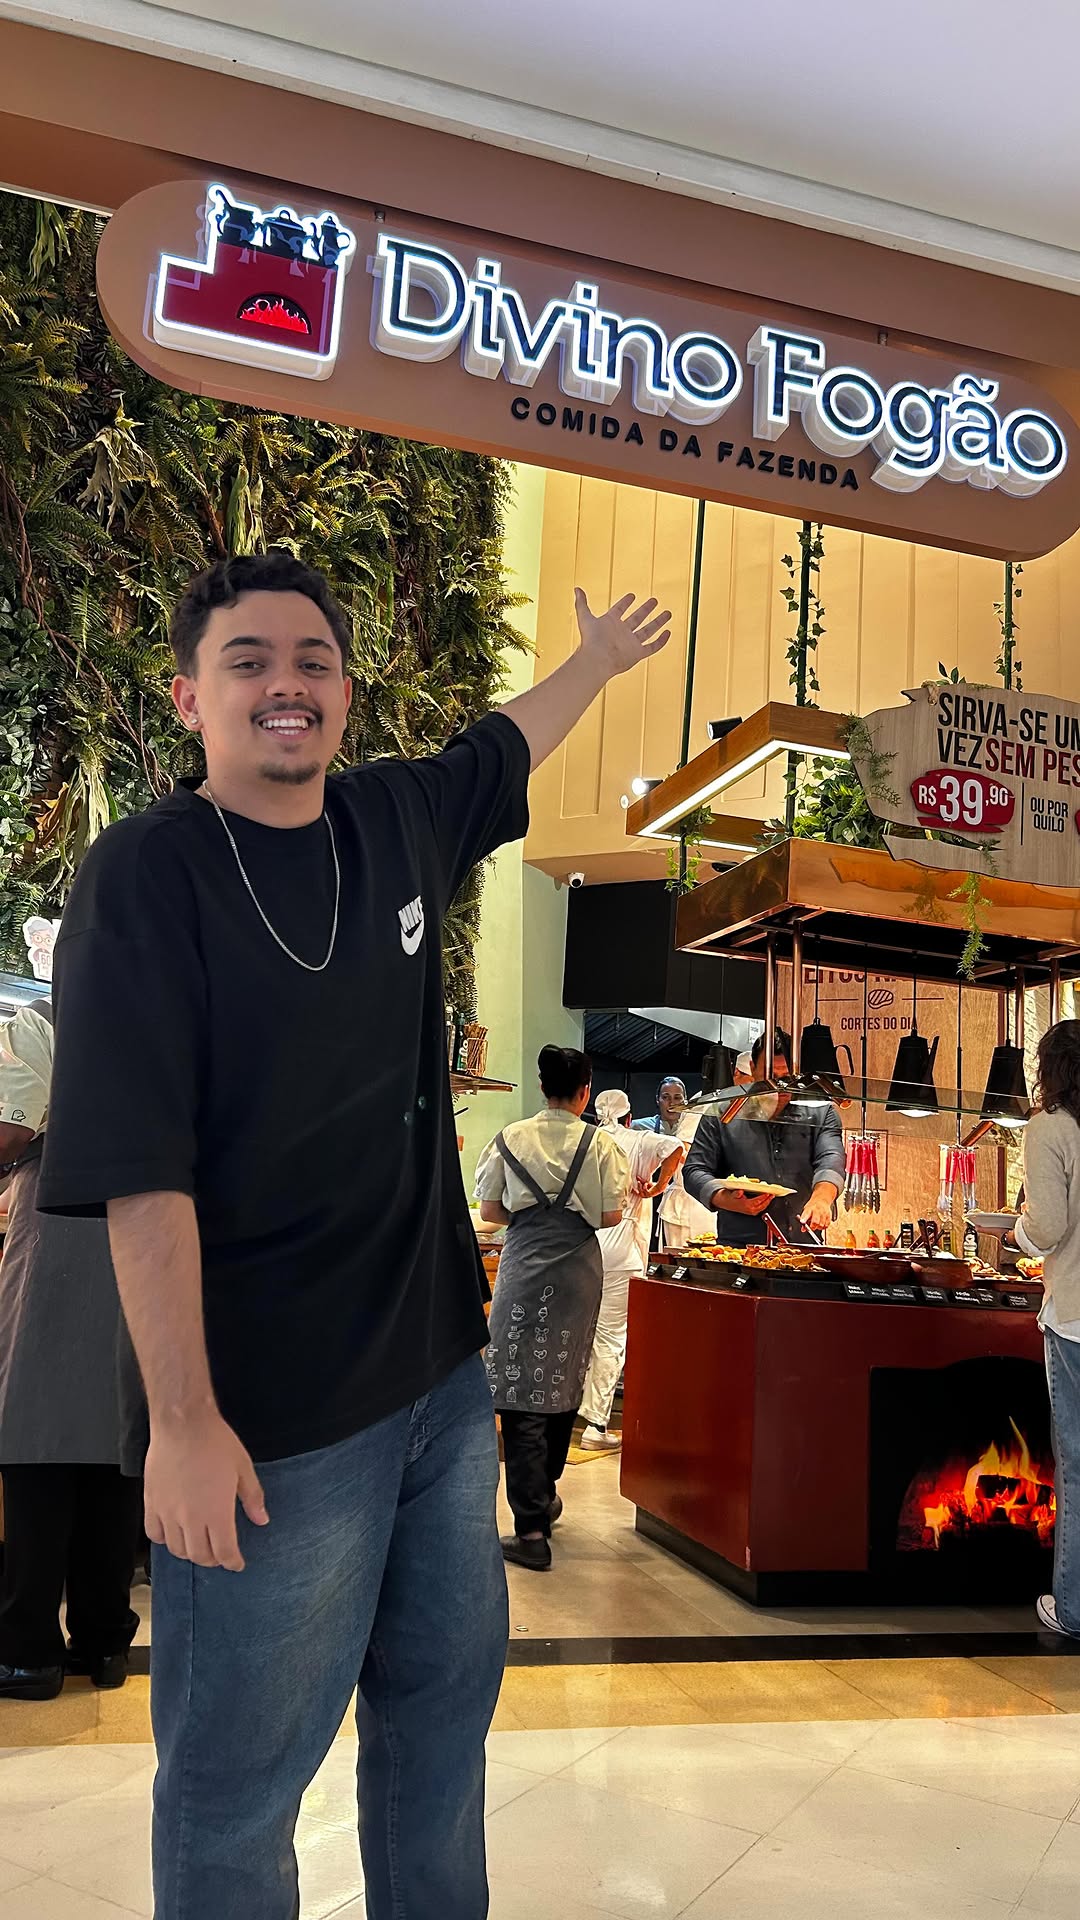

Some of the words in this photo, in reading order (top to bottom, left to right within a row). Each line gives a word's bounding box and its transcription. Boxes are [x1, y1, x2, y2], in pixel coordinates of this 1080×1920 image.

[377, 233, 743, 407] Divino
[760, 326, 1068, 479] Fogão
[511, 397, 644, 445] COMIDA
[660, 428, 702, 457] DA
[717, 441, 860, 491] FAZENDA
[937, 692, 1049, 747] SIRVA-SE
[937, 728, 983, 769] VEZ
[985, 738, 1036, 780] SEM
[1030, 797, 1045, 815] OU
[1047, 800, 1069, 818] POR
[1033, 814, 1065, 833] QUILO
[883, 1017, 897, 1030] DO
[900, 1017, 917, 1030] DI
